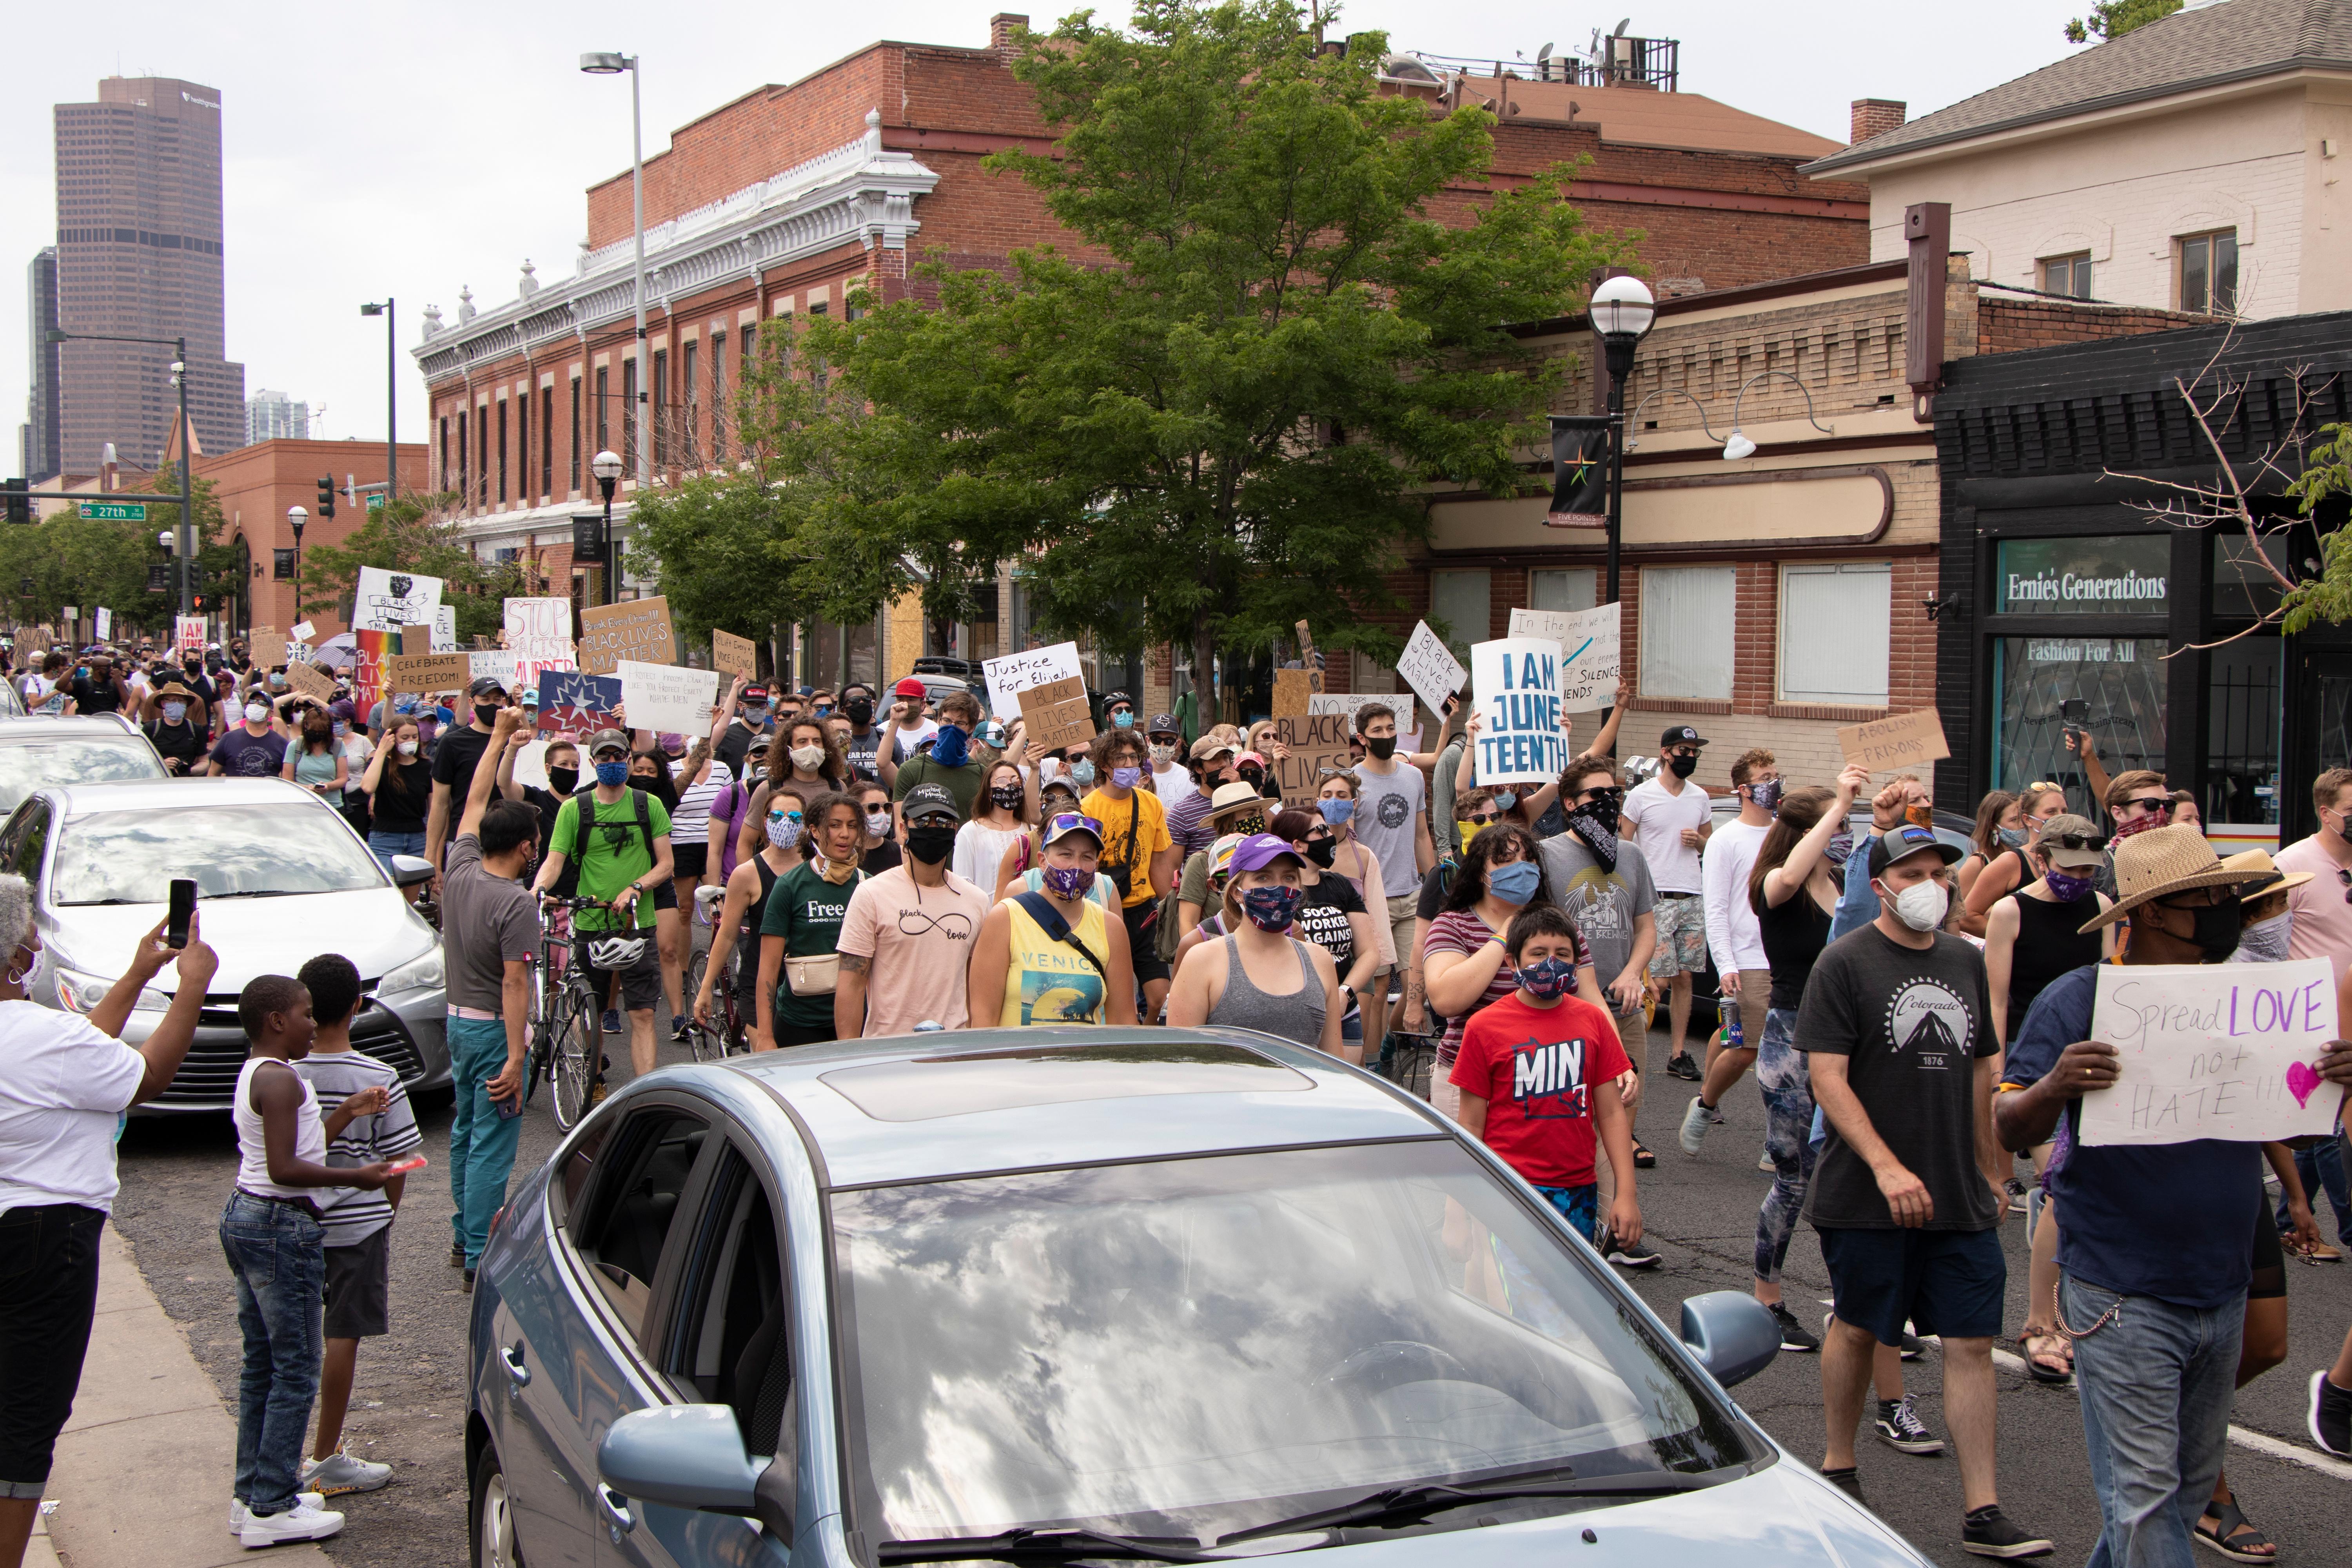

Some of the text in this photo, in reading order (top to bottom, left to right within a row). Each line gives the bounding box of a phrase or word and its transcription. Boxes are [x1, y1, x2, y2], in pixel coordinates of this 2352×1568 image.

[99, 507, 126, 517] 27th
[2008, 567, 2166, 601] Ernie's Generations
[381, 597, 413, 607] BLACK
[384, 610, 413, 621] LIVES
[506, 600, 568, 637] STOP
[1514, 608, 1613, 633] In the end we will
[181, 623, 202, 637] I AM
[375, 622, 401, 633] MATT
[584, 619, 607, 632] Break
[608, 617, 628, 629] Every
[16, 629, 49, 642] ASIAN
[586, 622, 668, 653] BLACK LIVES
[1595, 629, 1619, 646] not the
[258, 646, 283, 657] LIVES
[287, 643, 306, 652] ACK
[506, 637, 571, 659] RACIST
[721, 637, 746, 654] Lift Every
[2027, 641, 2135, 662] Fashion For All
[287, 652, 305, 661] VES
[356, 650, 395, 666] BLAC
[494, 651, 506, 659] TAY
[717, 651, 731, 663] VOICE
[737, 656, 753, 673] SING!
[1580, 652, 1620, 666] our enemies
[293, 663, 312, 678] BLACK
[397, 657, 457, 671] CELEBRATE
[987, 657, 1053, 678] Justice
[1503, 653, 1555, 691] I AM
[357, 669, 390, 683] LIV
[401, 673, 459, 686] FREEDOM!
[998, 667, 1068, 693] for Elijah
[1577, 665, 1620, 684] SILENCE
[292, 676, 320, 697] MATTER
[356, 685, 381, 701] MAT
[646, 682, 656, 691] YOU
[659, 682, 681, 693] PROTECT
[683, 685, 702, 697] GUILTY
[1563, 686, 1593, 700] IENDS
[650, 693, 688, 704] WHITE MEN
[1033, 684, 1072, 706] BLACK
[1313, 699, 1340, 715] NO
[1491, 694, 1561, 733] JUNE
[1036, 705, 1077, 730] LIVES
[2024, 716, 2047, 726] never
[2087, 715, 2136, 729] mainstream
[1041, 725, 1084, 746] MATTER
[1278, 715, 1347, 748] BLACK
[1858, 717, 1917, 742] ABOLISH
[1479, 735, 1568, 775] TEENTH
[1864, 738, 1924, 763] PRISONS
[1158, 782, 1181, 799] ACK
[899, 909, 923, 918] black
[1301, 915, 1349, 931] WORKER
[947, 928, 967, 940] love
[1304, 928, 1353, 944] AGAINST
[1323, 941, 1351, 954] LICE
[1896, 995, 1960, 1016] Colorado
[2110, 979, 2327, 1052] Spread LOVE
[1923, 1056, 1943, 1065] 1876
[2190, 1044, 2249, 1079] not
[1514, 1040, 1581, 1098] MIN
[2132, 1080, 2244, 1130] HATE
